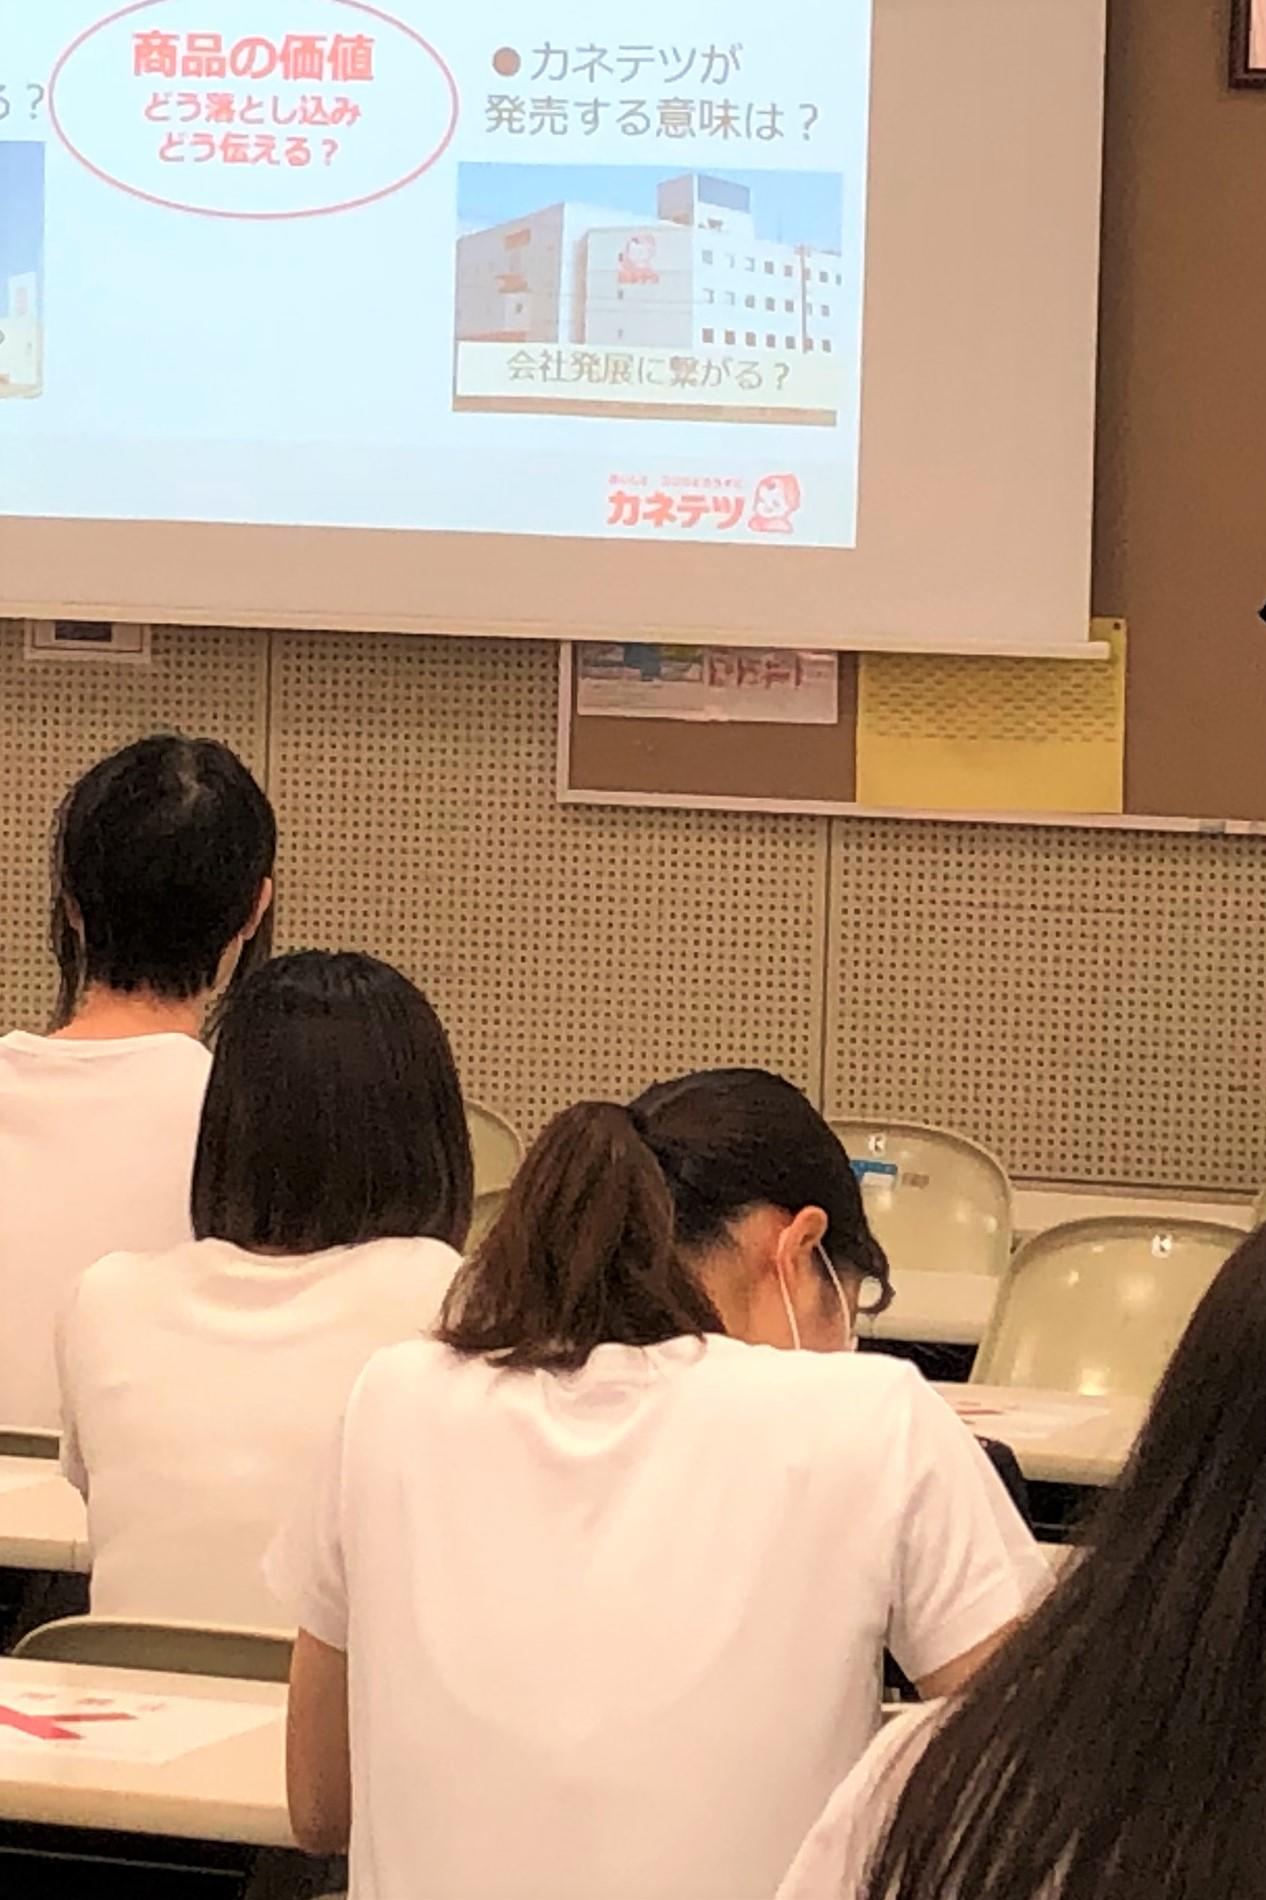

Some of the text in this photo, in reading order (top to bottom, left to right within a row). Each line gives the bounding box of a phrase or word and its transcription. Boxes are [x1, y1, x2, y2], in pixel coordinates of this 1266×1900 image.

[132, 30, 375, 81] 商品の価値
[144, 91, 362, 126] どう落とし込み
[485, 94, 818, 140] 発売する意味は？
[159, 131, 338, 166] どう伝える？
[506, 349, 790, 390] 会社発展に繋がる？
[607, 490, 745, 530] カネテツ
